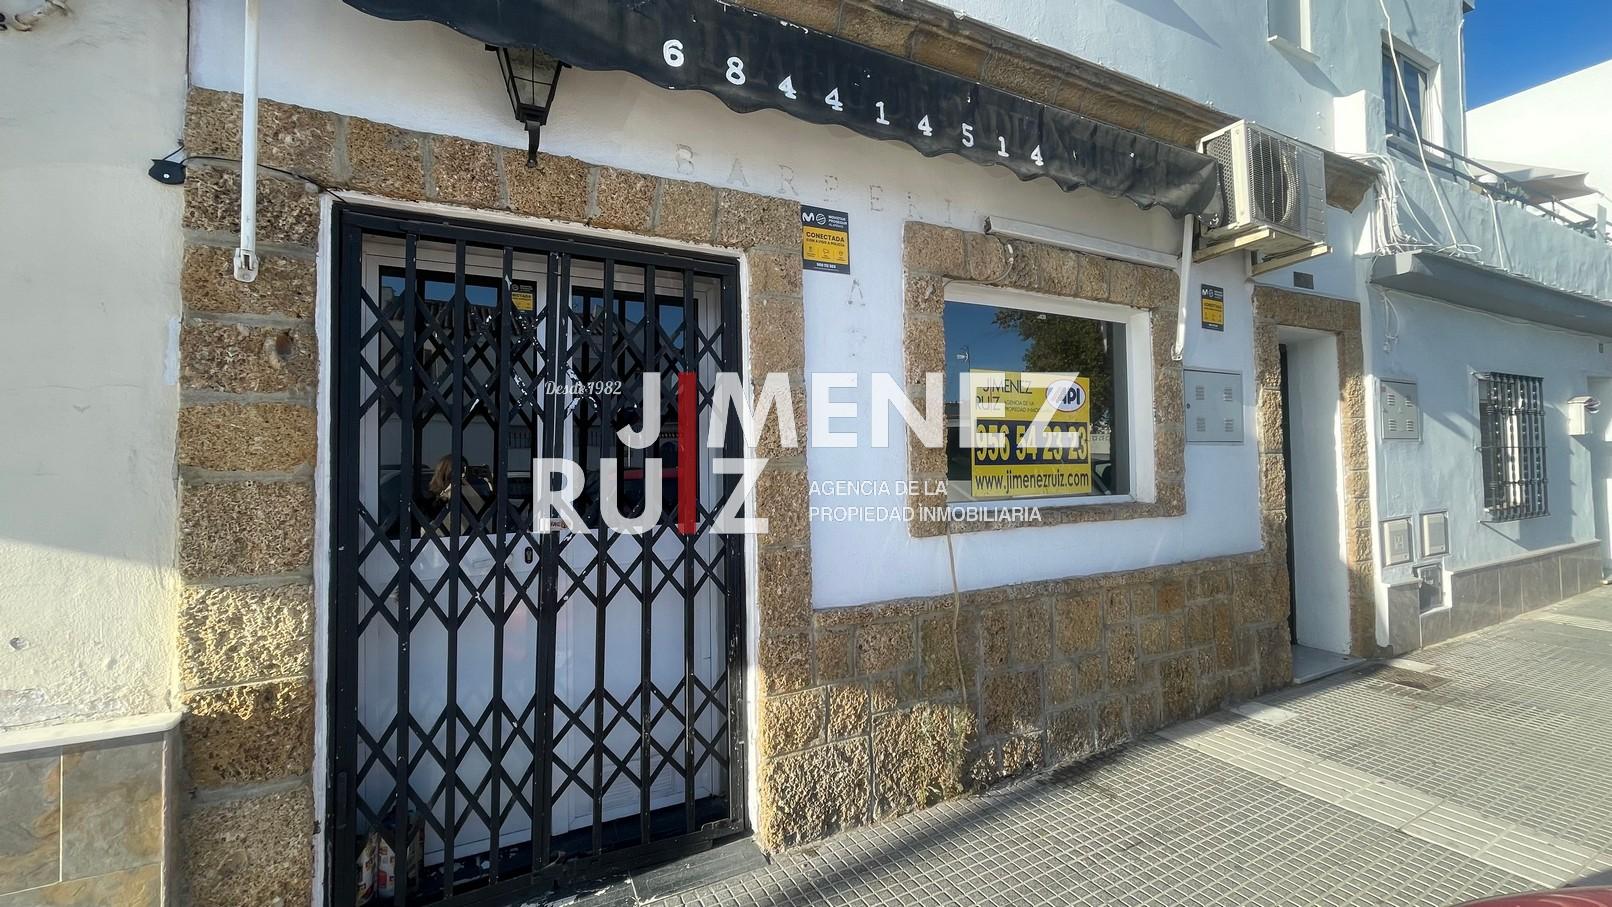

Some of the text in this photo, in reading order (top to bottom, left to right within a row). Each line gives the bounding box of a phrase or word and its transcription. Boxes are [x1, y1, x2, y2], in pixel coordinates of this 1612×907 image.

[806, 232, 845, 242] CONECTADA
[983, 376, 1033, 395] JIMENEZ
[976, 424, 1088, 461] 956 54 23 23
[976, 469, 1088, 493] www.jimenezruiz.com
